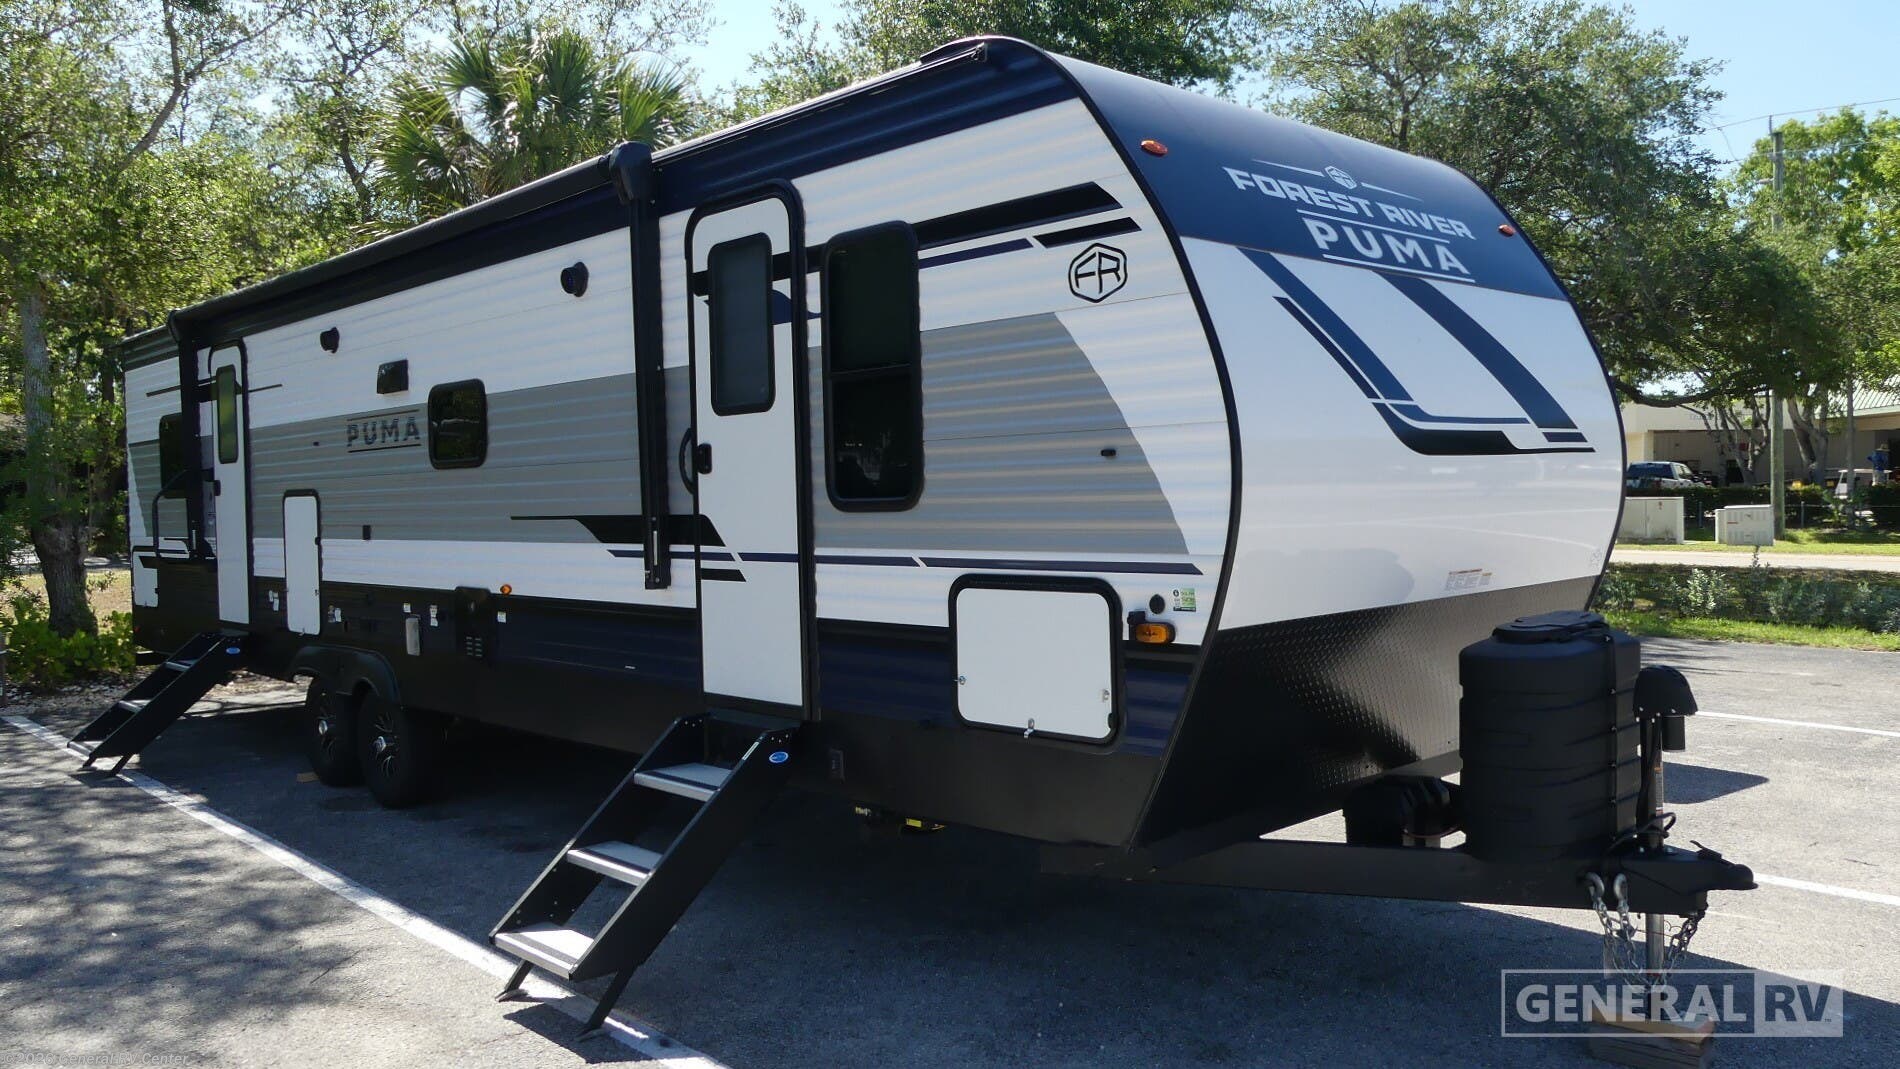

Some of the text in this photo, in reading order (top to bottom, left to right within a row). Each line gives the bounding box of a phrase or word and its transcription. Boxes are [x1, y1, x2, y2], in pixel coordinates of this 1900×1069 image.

[1222, 166, 1476, 240] FOREST RIVER
[1303, 217, 1470, 275] PUMA
[346, 416, 421, 447] PUMA
